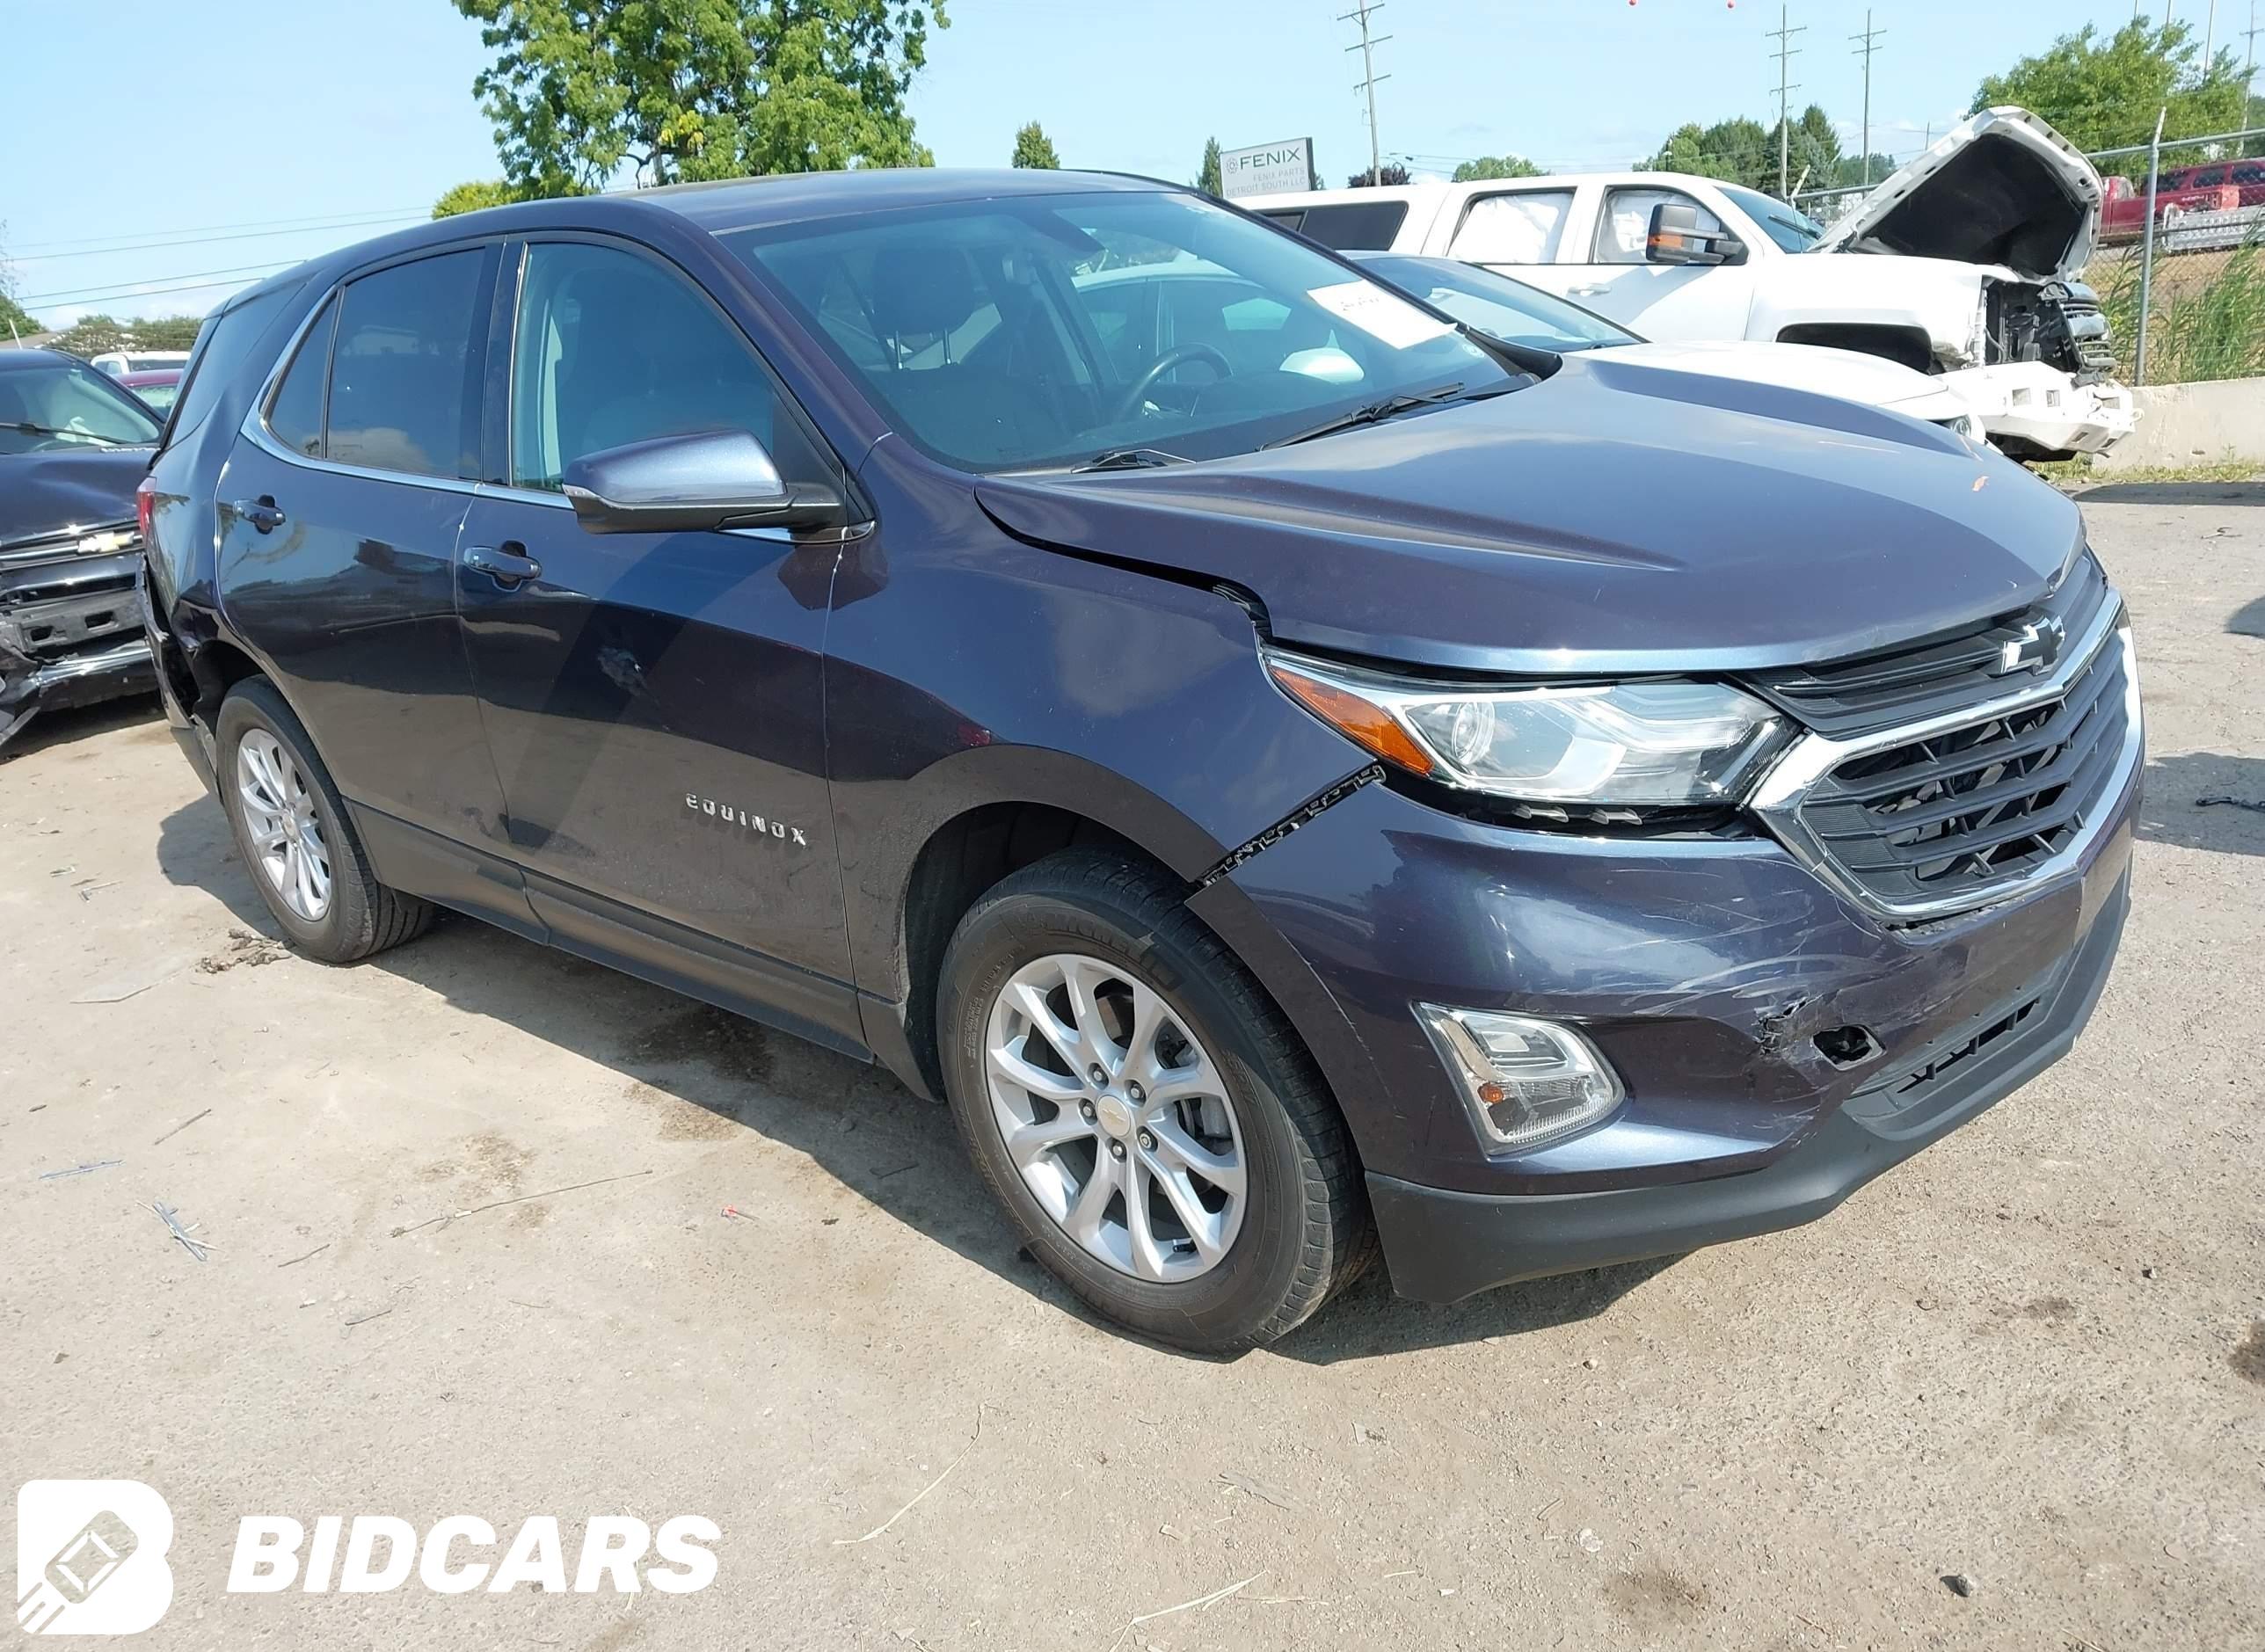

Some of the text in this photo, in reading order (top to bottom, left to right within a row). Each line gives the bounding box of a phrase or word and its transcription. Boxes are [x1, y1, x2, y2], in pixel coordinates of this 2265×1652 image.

[1240, 147, 1300, 170] FENIX
[1253, 167, 1305, 182] FENIX PARTS
[1227, 177, 1306, 197] DETROIT SOUTH LLC
[686, 793, 806, 846] EQUINOX
